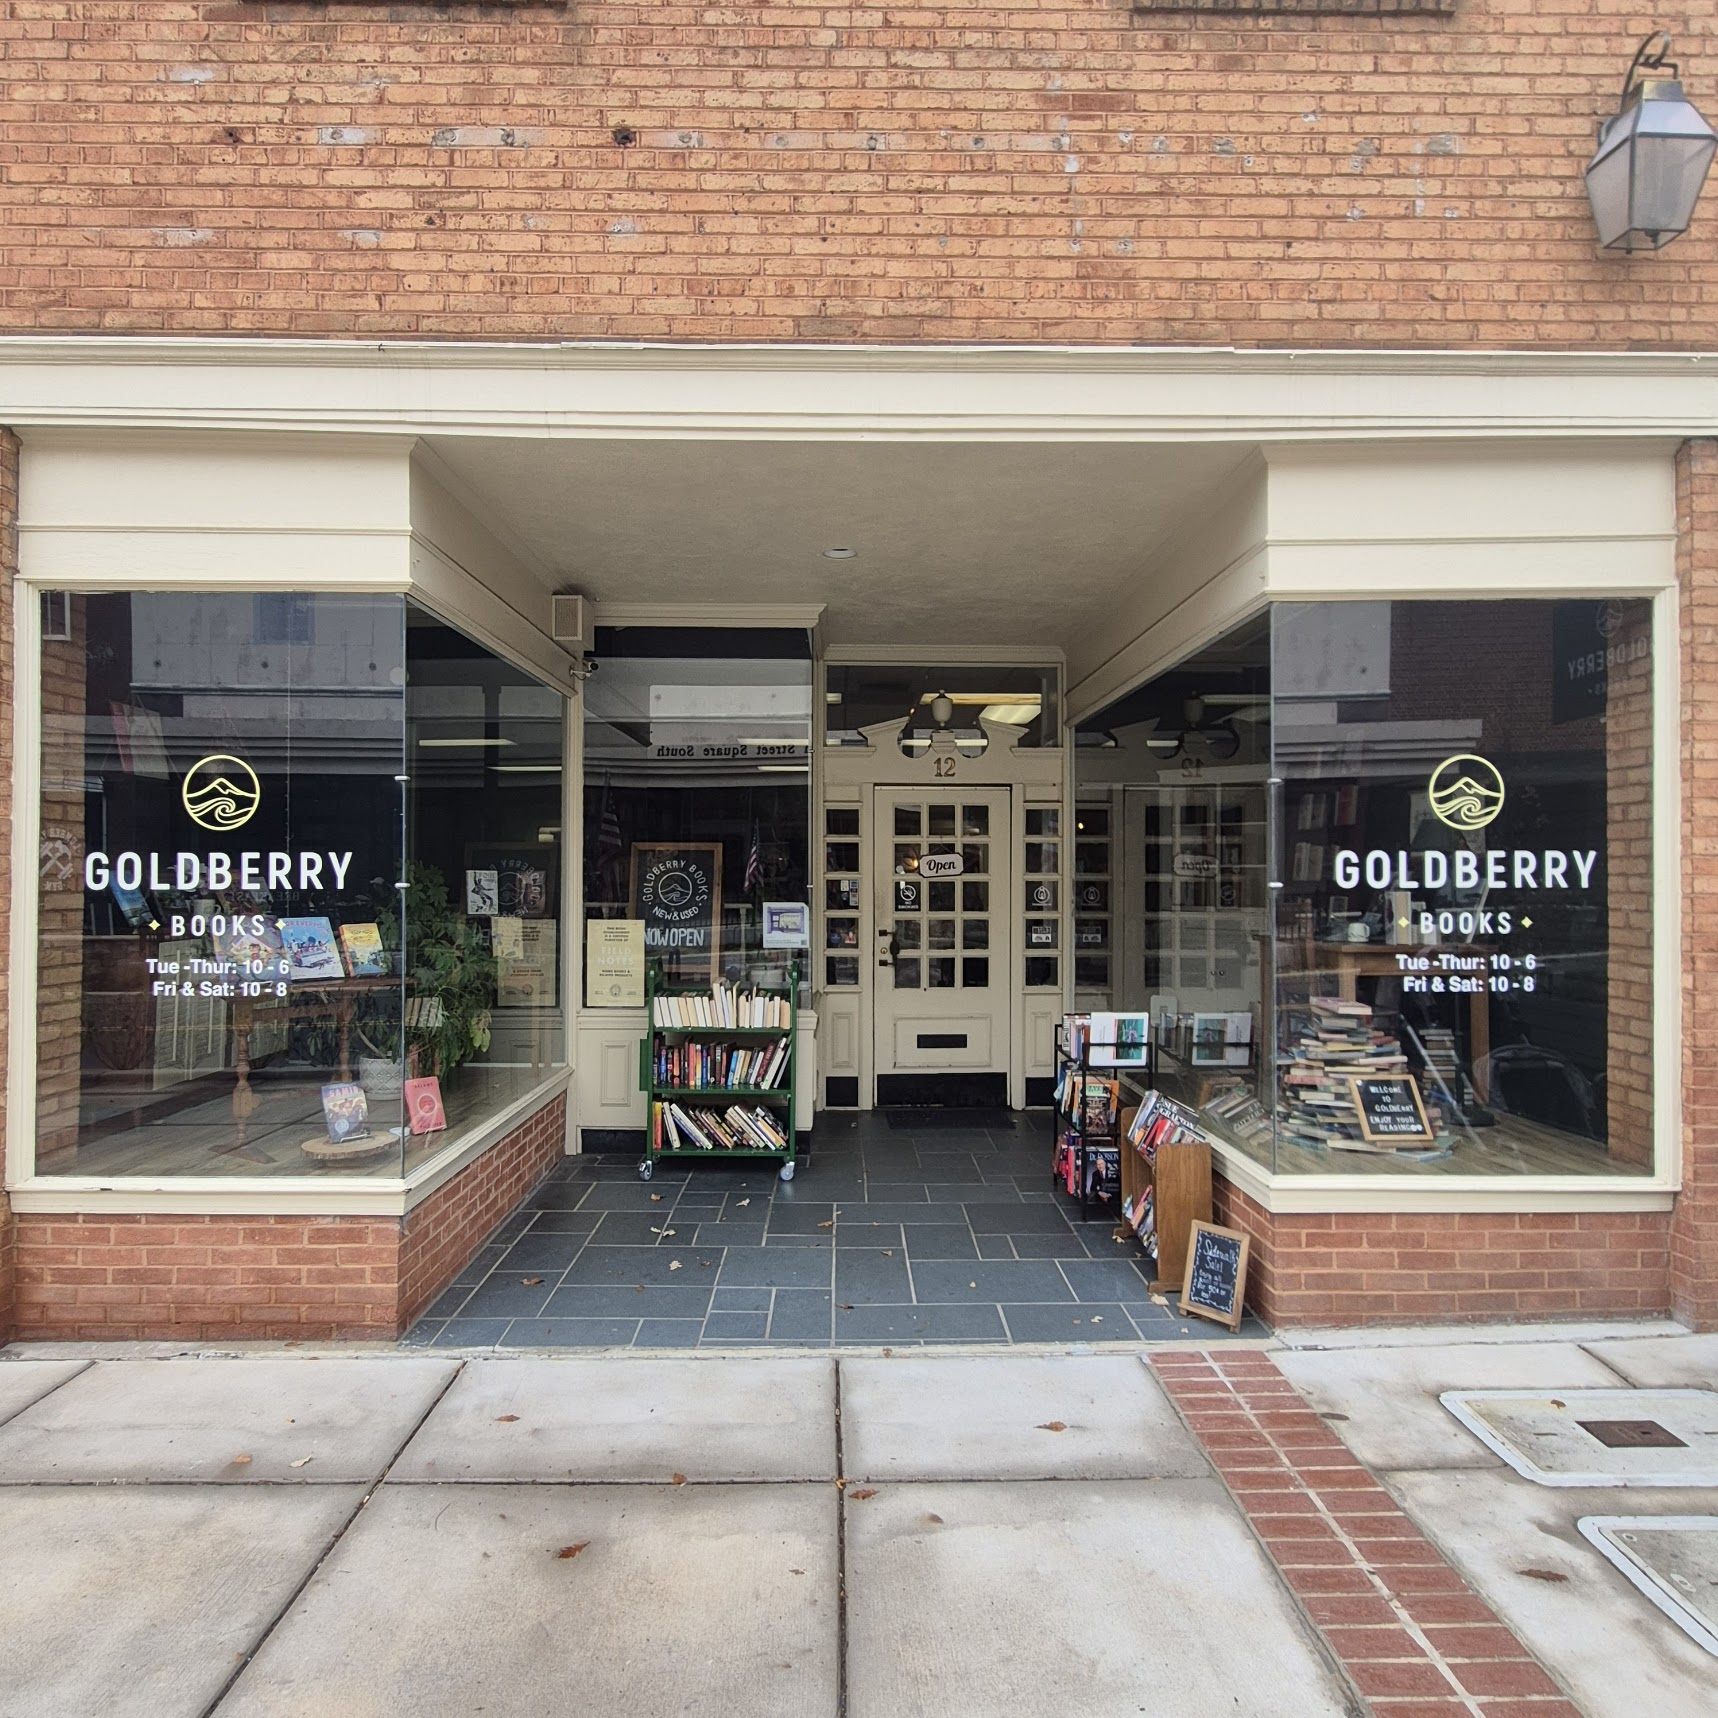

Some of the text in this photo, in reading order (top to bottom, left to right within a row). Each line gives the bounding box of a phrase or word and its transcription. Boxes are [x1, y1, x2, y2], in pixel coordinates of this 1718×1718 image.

[933, 757, 956, 777] 12
[86, 851, 353, 891] GOLDBERRY
[926, 859, 956, 875] Open
[1335, 850, 1597, 889] GOLDBERRY
[643, 860, 709, 902] GOLDBERRY BOOKS
[652, 906, 699, 920] NEW & USED
[171, 915, 265, 937] BOOKS
[1420, 912, 1512, 935] BOOKS
[644, 927, 704, 947] NOW OPEN
[146, 959, 180, 974] Tue
[243, 959, 263, 974] 10
[279, 960, 290, 975] 6
[1395, 954, 1430, 970] Tue
[1490, 954, 1510, 970] 10
[1525, 954, 1536, 970] 6
[153, 981, 177, 996] Fri
[182, 981, 195, 996] &
[200, 981, 235, 996] Sat:
[241, 981, 260, 996] 10
[276, 981, 287, 996] 8
[1403, 976, 1427, 992] Fri
[1430, 976, 1445, 992] &
[1450, 976, 1484, 992] Sat:
[1489, 976, 1509, 992] 10
[1523, 976, 1535, 992] 8
[1369, 1086, 1402, 1094] WELCOME
[1382, 1095, 1391, 1103] TO
[1374, 1104, 1414, 1113] GOLDBERRY
[1369, 1115, 1392, 1124] ENJOY
